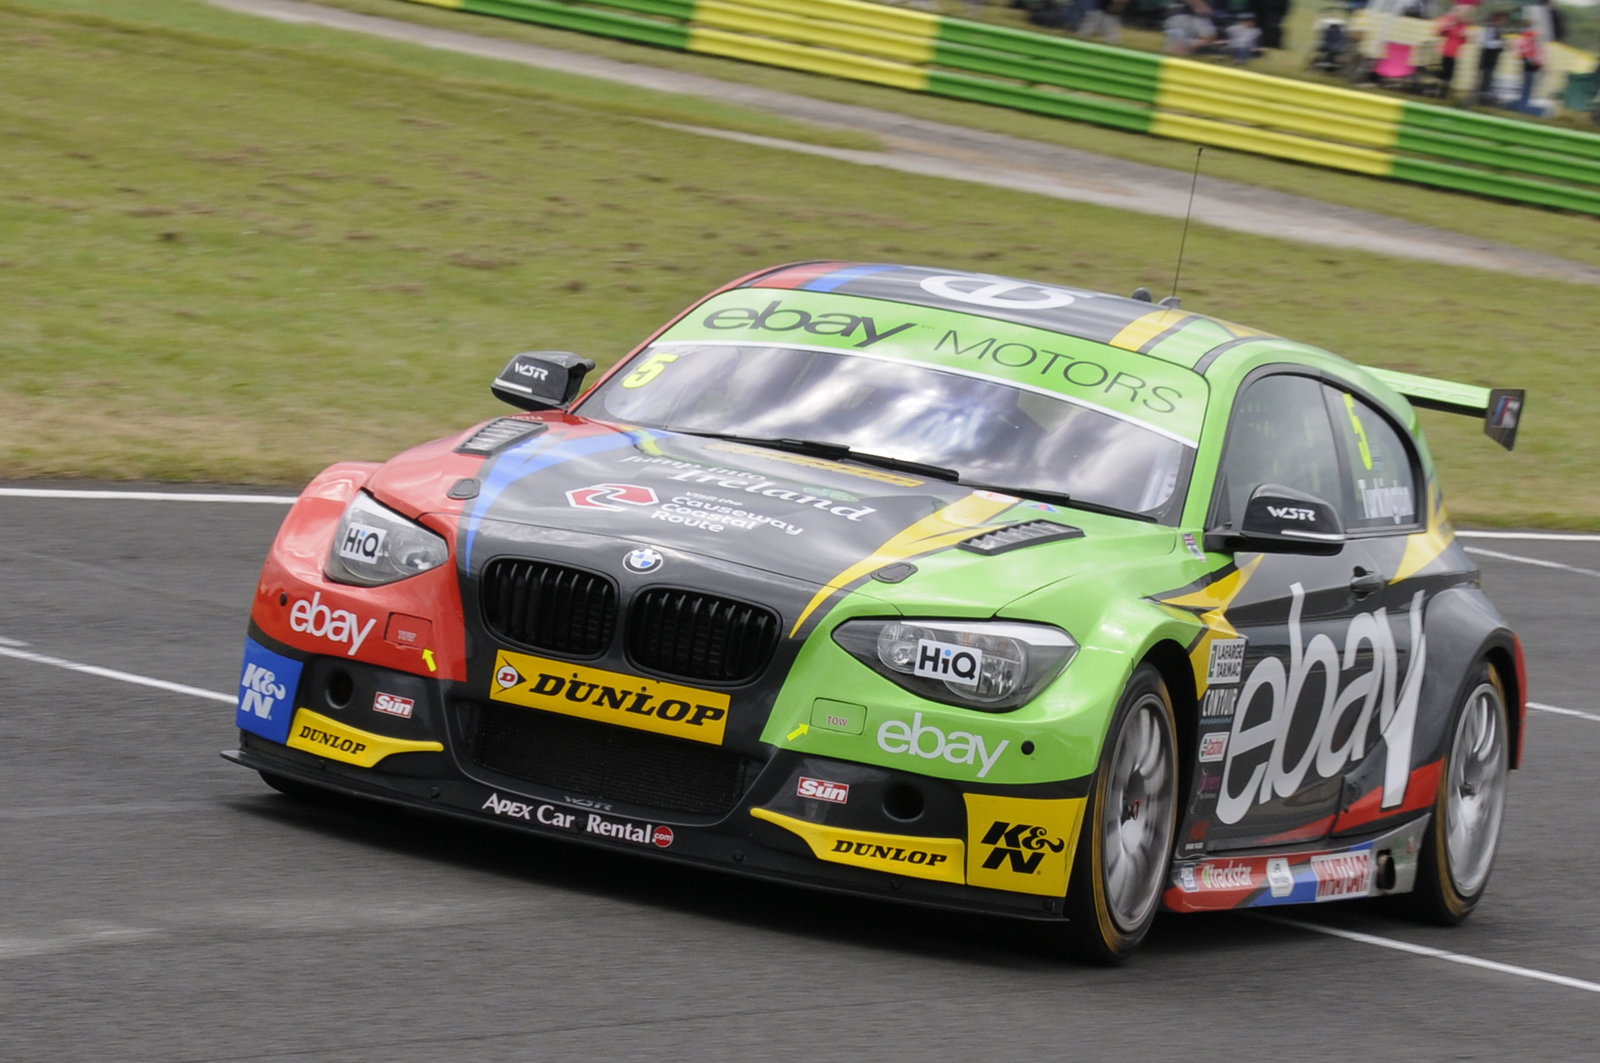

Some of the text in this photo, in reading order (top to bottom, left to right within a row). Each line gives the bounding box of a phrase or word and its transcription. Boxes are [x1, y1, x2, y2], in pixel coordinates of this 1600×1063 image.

[514, 361, 549, 382] WSR
[621, 353, 681, 390] 5
[702, 300, 1184, 415] ebay MOTORS
[1343, 393, 1374, 471] 5
[666, 468, 879, 523] Ireland
[650, 509, 725, 533] Route
[660, 502, 757, 530] Coastal
[671, 496, 805, 536] Causeway
[1266, 505, 1316, 522] WSR
[343, 527, 380, 558] HiQ
[289, 591, 377, 656] ebay
[917, 645, 977, 680] HiQ
[241, 662, 286, 701] K&
[241, 688, 273, 720] N
[375, 695, 411, 715] Sun
[529, 673, 726, 726] DUNLOP
[1215, 581, 1427, 825] ebay
[825, 715, 849, 727] TOW
[298, 725, 367, 756] DUNLOP
[876, 712, 1009, 778] ebay
[799, 780, 847, 801] Sun
[536, 803, 576, 829] Car
[831, 839, 947, 867] DUNLOP
[980, 820, 1066, 855] K&
[981, 846, 1046, 875] N
